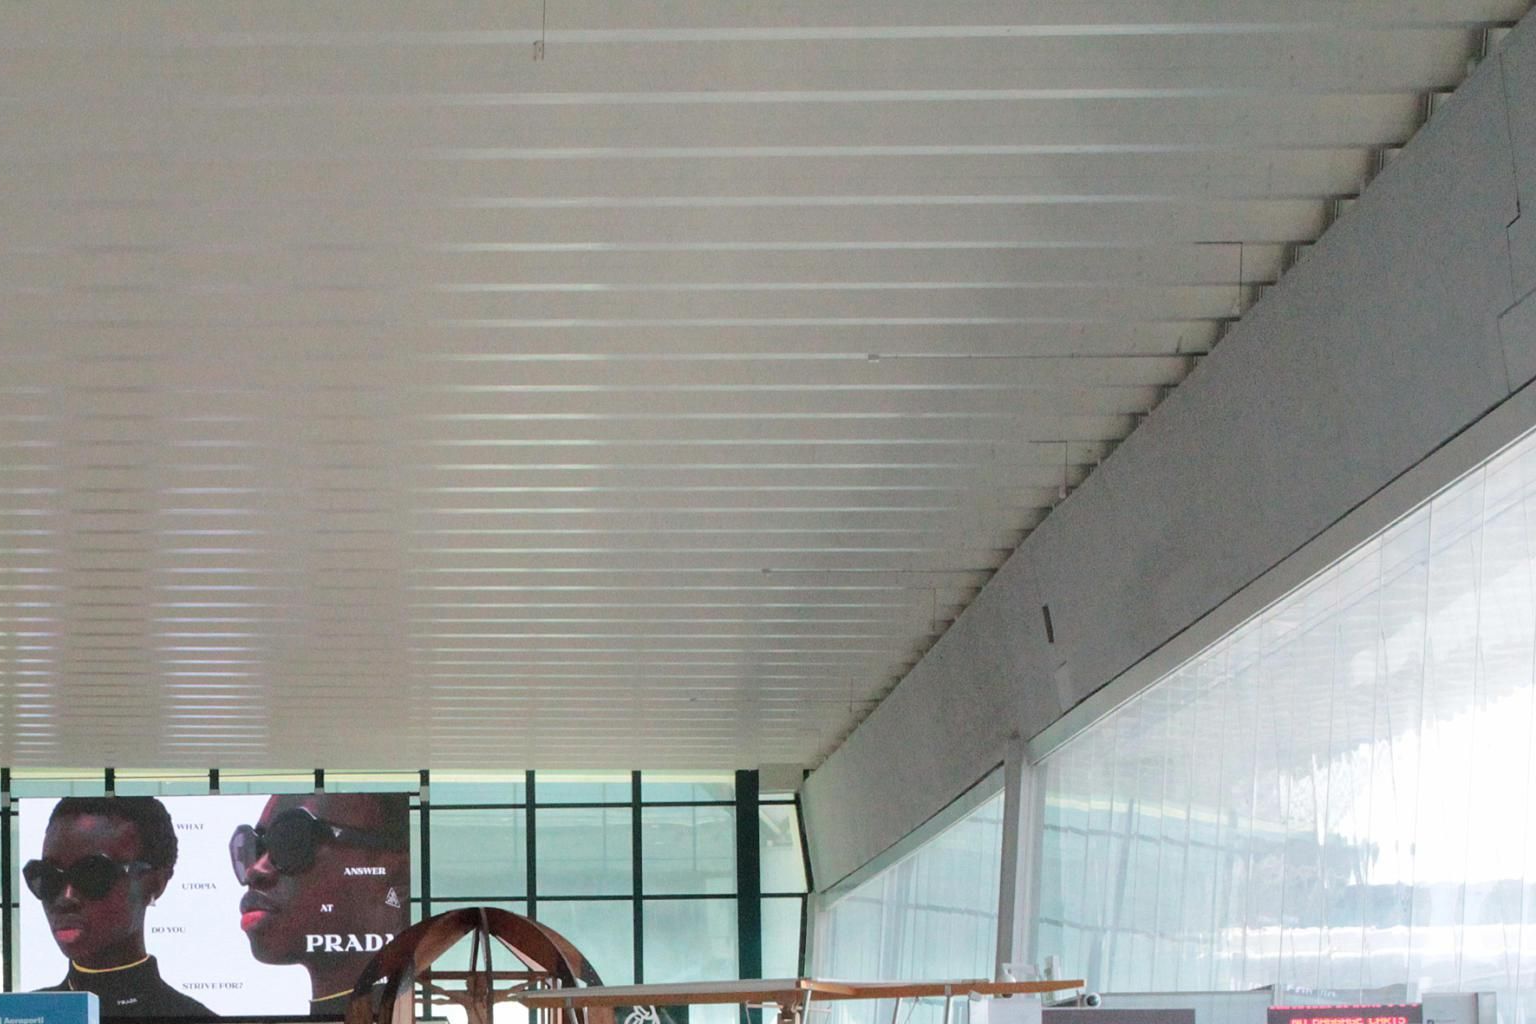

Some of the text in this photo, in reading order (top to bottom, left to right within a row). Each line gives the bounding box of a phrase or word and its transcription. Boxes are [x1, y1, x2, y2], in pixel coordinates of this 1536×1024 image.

[176, 823, 204, 831] WHAT
[344, 866, 386, 876] ANSWER
[181, 882, 217, 890] UTOPIA
[320, 904, 334, 913] AT
[151, 926, 186, 934] DO YOU
[182, 980, 243, 990] STRIVE FOR?
